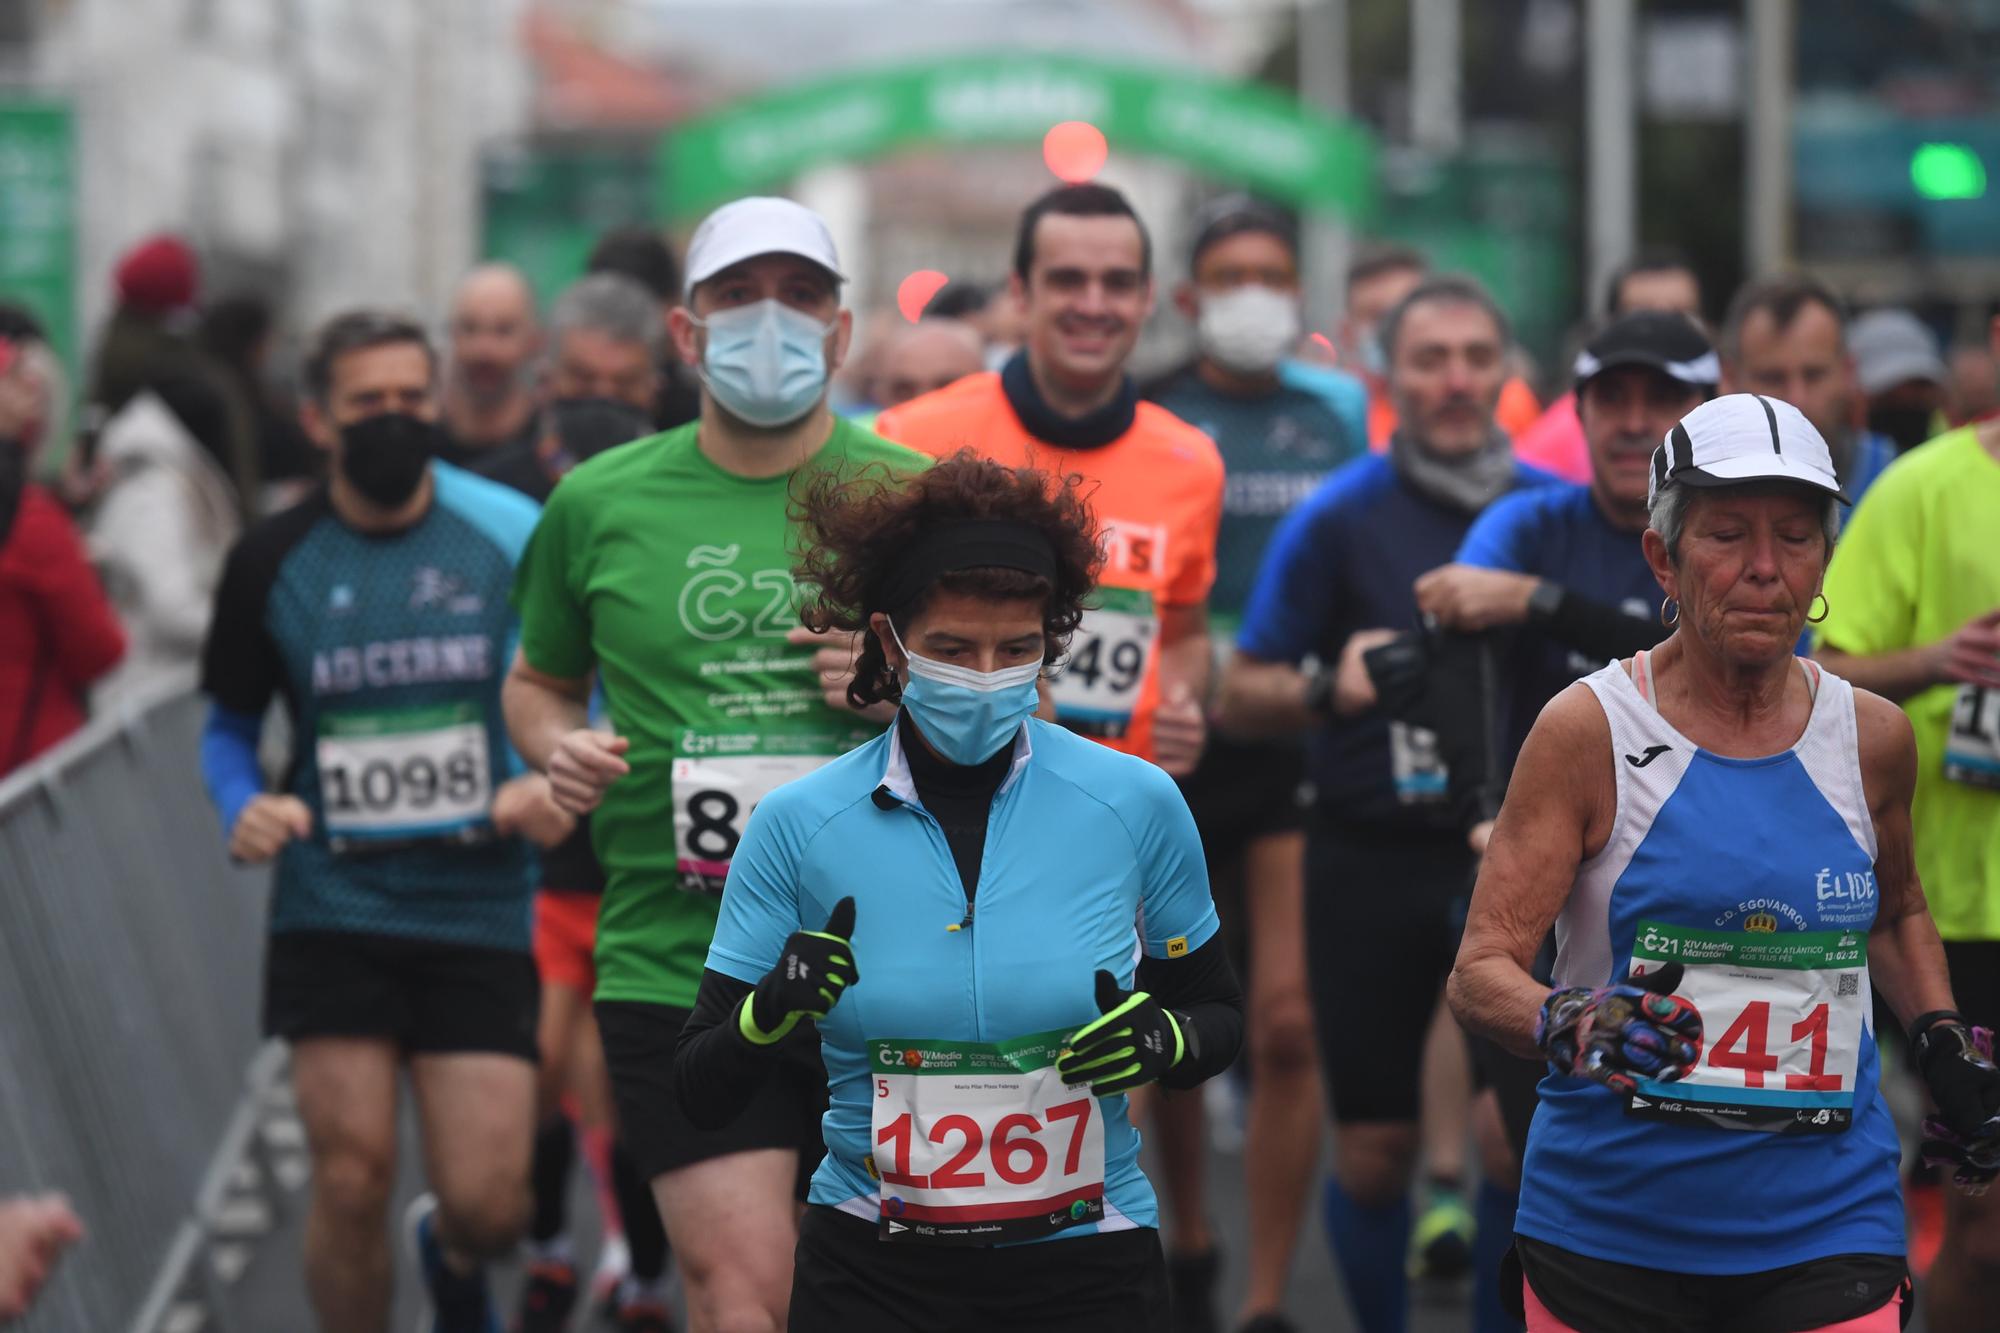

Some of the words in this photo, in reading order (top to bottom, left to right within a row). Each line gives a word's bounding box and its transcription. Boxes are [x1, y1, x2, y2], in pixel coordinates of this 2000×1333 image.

[1049, 636, 1142, 693] 49
[1955, 684, 2000, 746] 1
[319, 751, 479, 815] 1098
[686, 789, 757, 862] 8
[1815, 868, 1874, 902] ÉLIDE
[1739, 898, 1808, 931] EGOVARROS
[1682, 949, 1726, 959] Maratón
[1684, 939, 1701, 949] XIV
[1702, 942, 1734, 952] Media
[931, 1051, 962, 1061] Media
[878, 1079, 889, 1098] 5
[878, 1097, 1092, 1190] 1267
